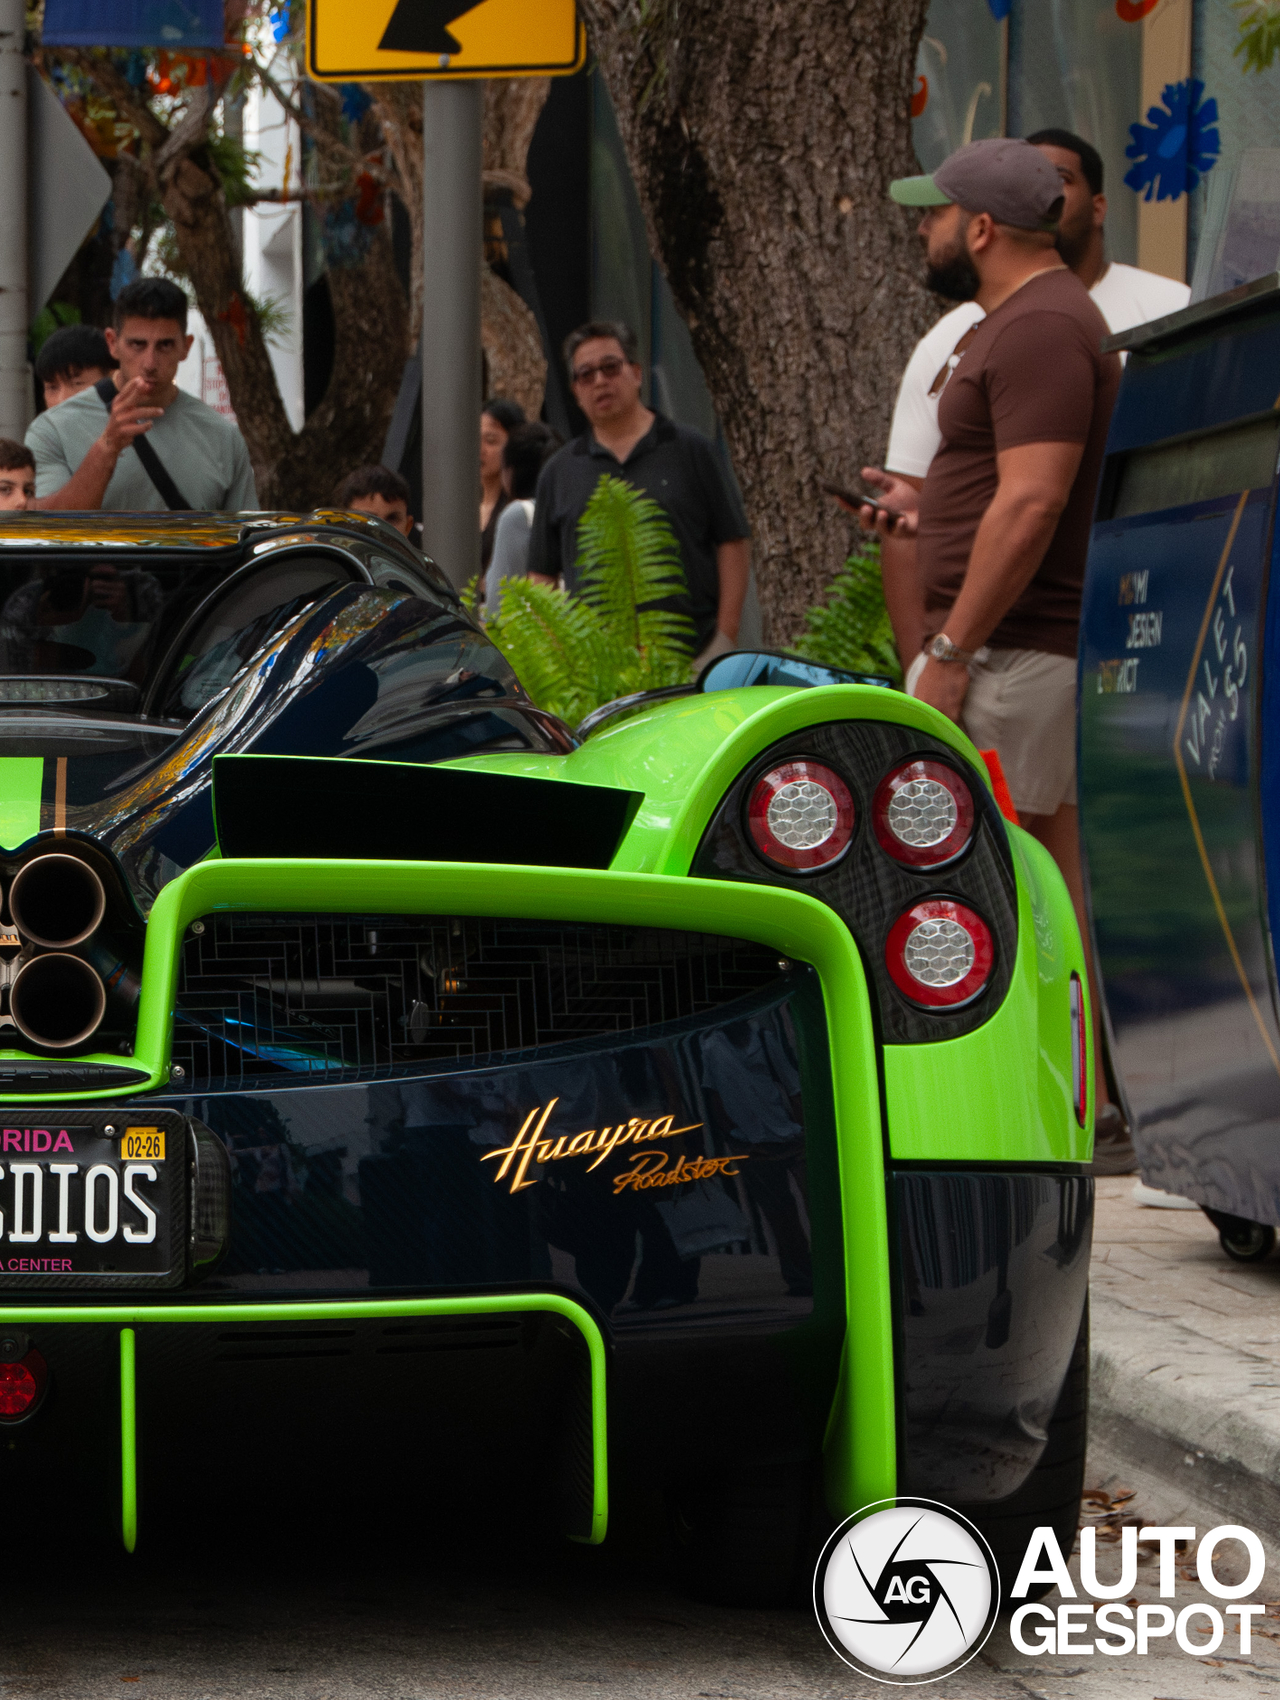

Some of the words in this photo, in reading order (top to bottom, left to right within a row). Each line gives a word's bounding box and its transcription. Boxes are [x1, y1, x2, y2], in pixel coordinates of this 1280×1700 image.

[1186, 565, 1235, 765] VALET
[127, 1136, 160, 1158] 02-26
[479, 1097, 704, 1194] Huayra
[612, 1150, 750, 1194] Roadster
[8, 1257, 72, 1271] CENTER
